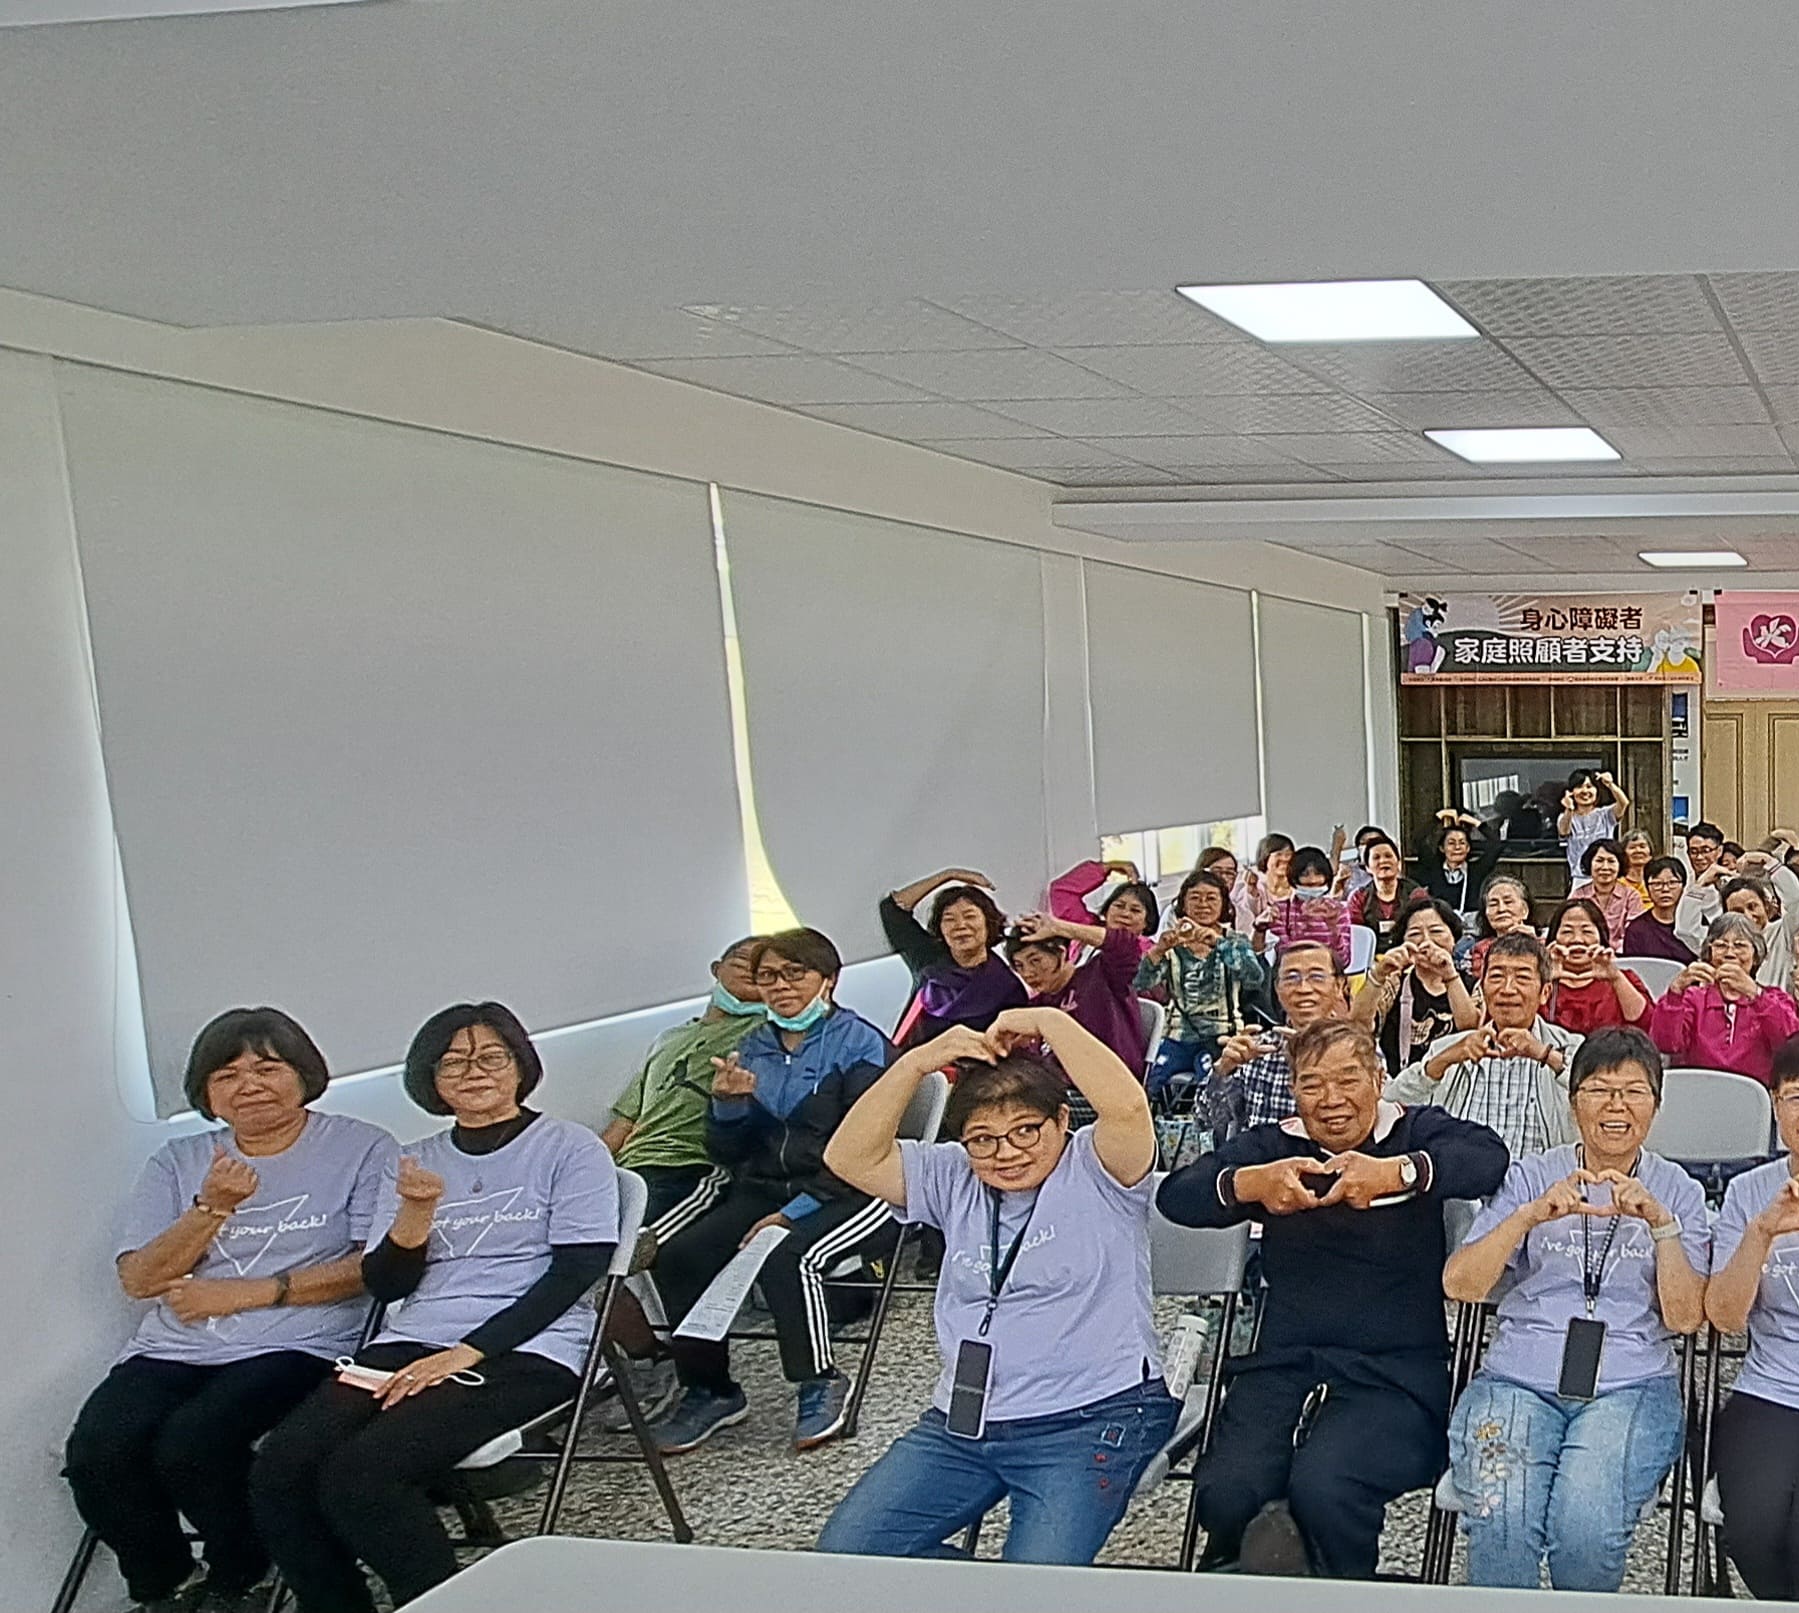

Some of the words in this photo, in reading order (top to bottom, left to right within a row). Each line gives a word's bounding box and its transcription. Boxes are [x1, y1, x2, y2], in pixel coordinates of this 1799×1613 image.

[1519, 606, 1643, 631] 身心障礙者
[1454, 635, 1643, 665] 家庭照顧者支持
[229, 1225, 273, 1239] your
[277, 1214, 327, 1232] back!
[452, 1215, 491, 1230] your
[494, 1208, 540, 1222] back!
[973, 1259, 992, 1274] go
[1020, 1225, 1056, 1252] ack!
[1772, 1260, 1797, 1277] got
